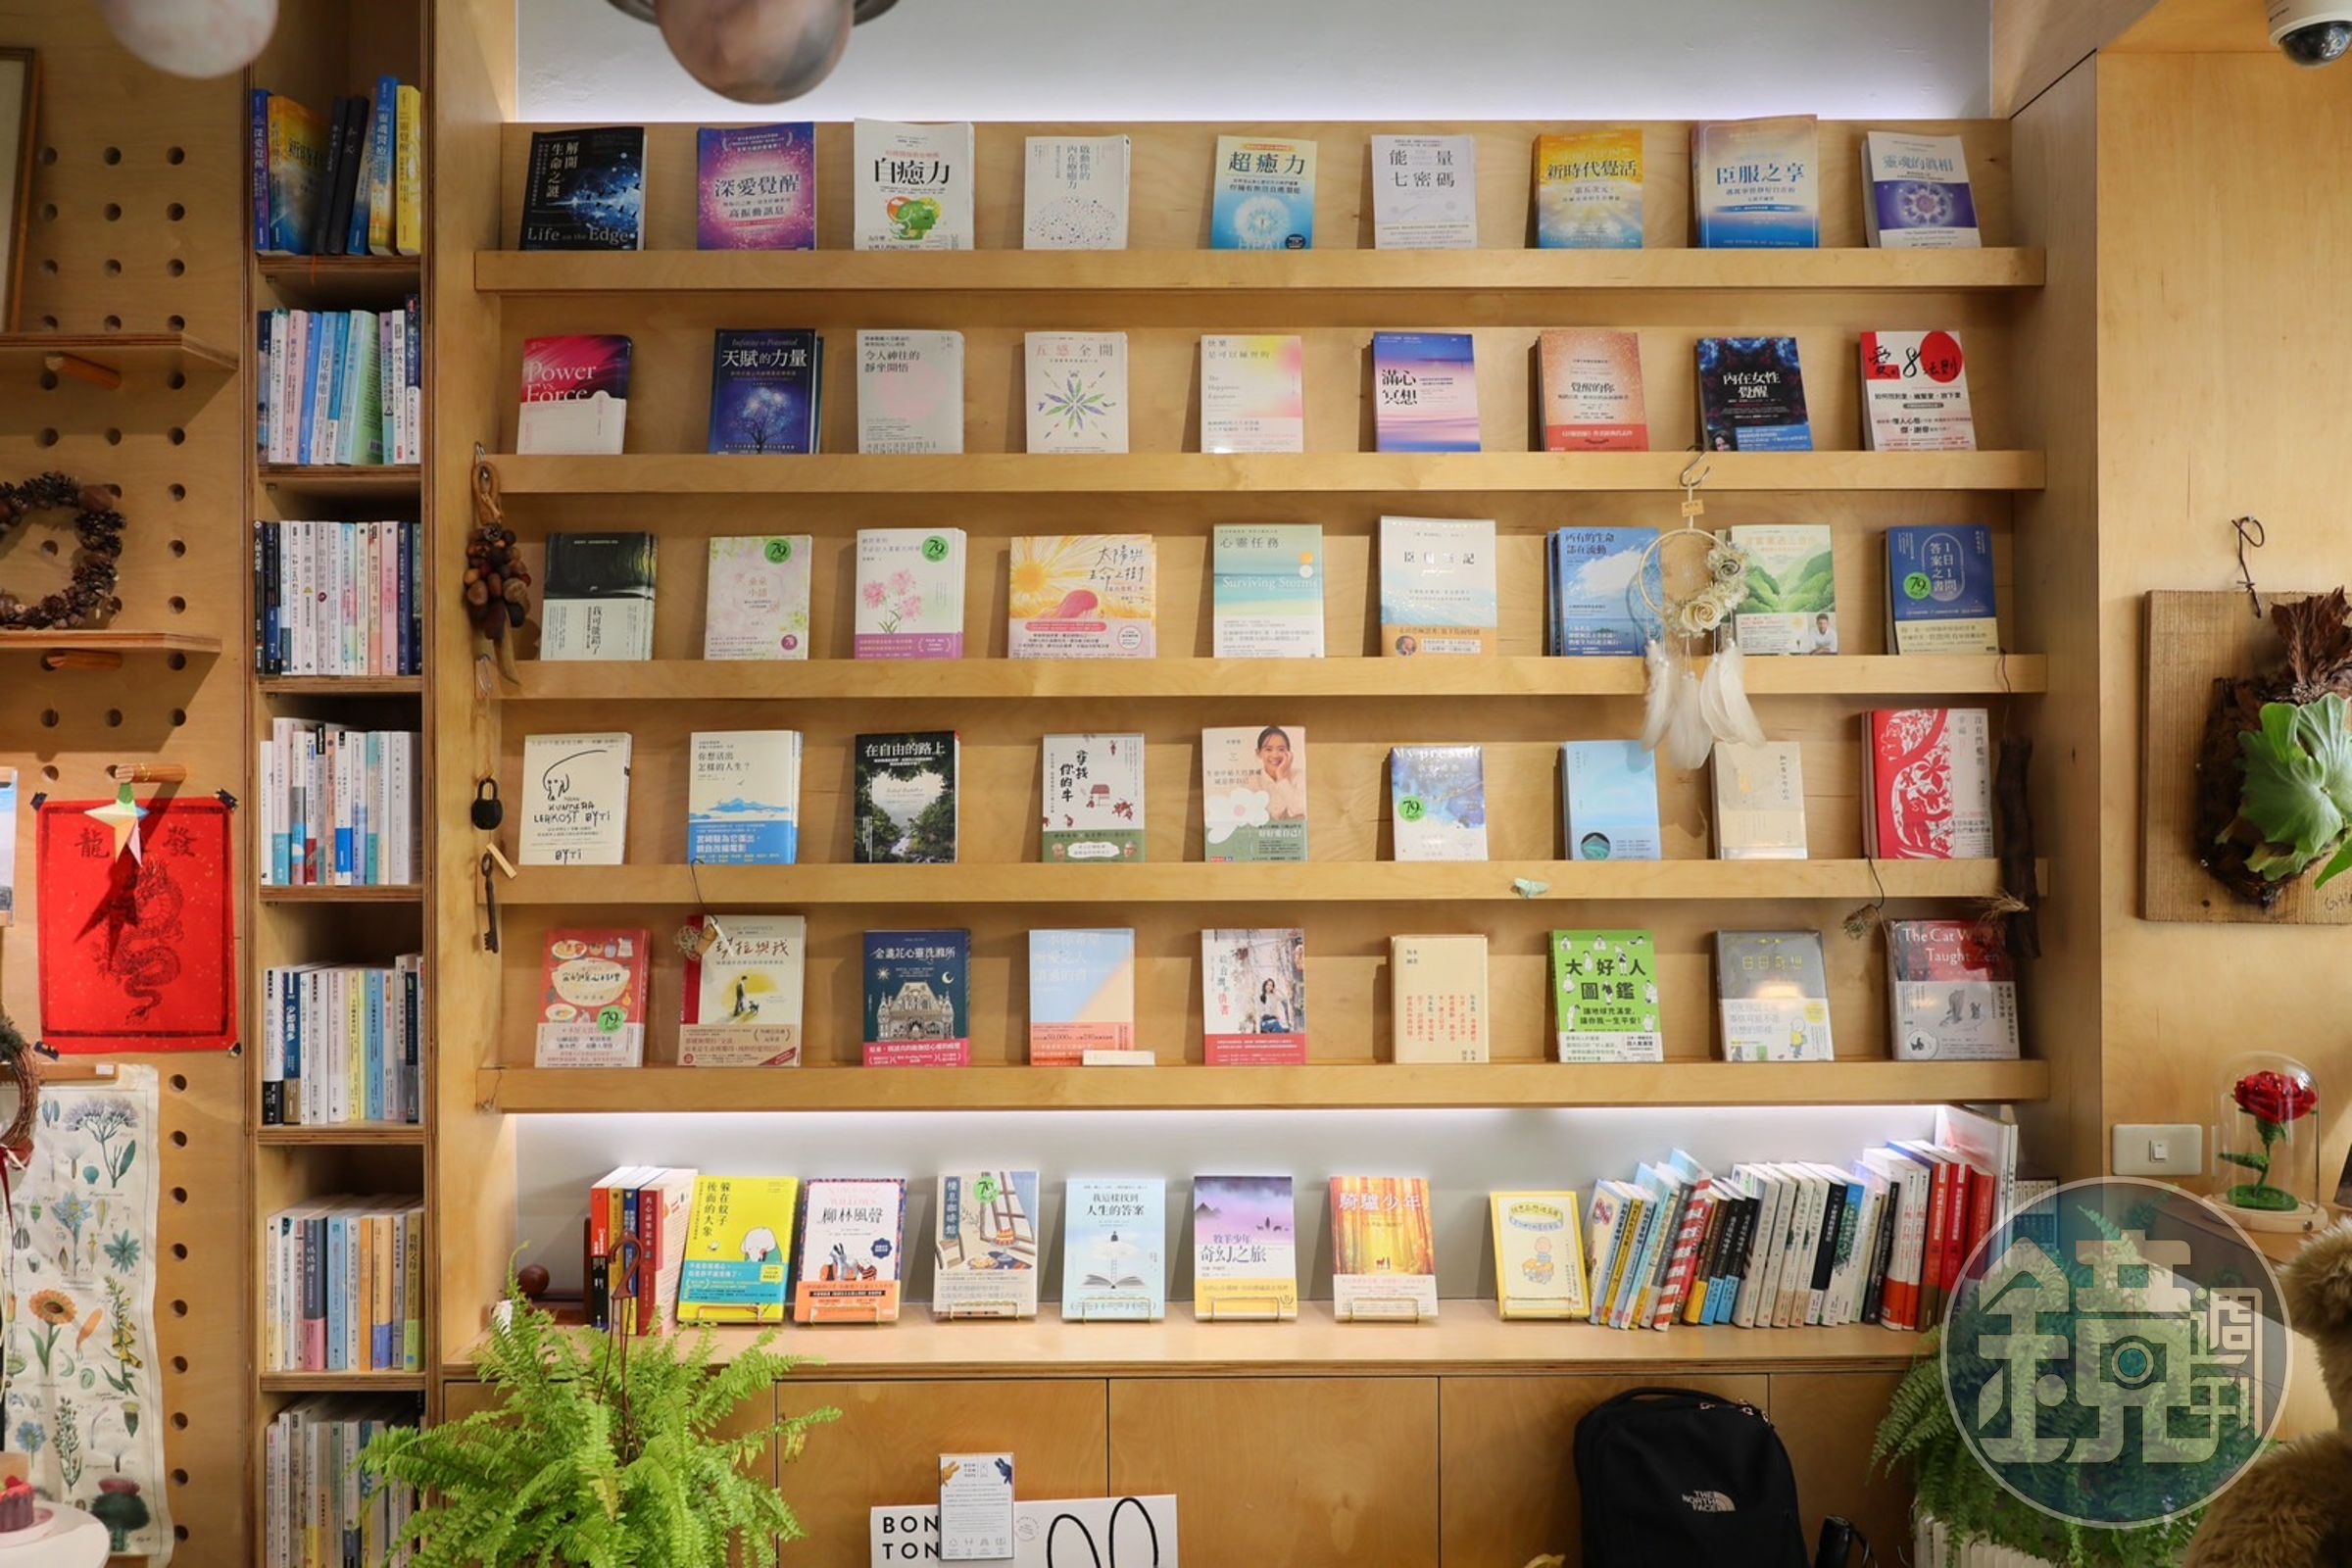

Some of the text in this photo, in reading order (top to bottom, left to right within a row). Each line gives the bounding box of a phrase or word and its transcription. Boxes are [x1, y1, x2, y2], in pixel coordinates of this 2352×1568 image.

[564, 141, 579, 171] 解開
[1228, 152, 1305, 175] 超癒力
[547, 142, 565, 198] 生命之謎
[874, 157, 950, 185] 自癒力
[1546, 160, 1638, 180] 新時代覺活
[1716, 163, 1805, 185] 臣服之享
[713, 174, 800, 197] 深愛覺醒
[1394, 172, 1455, 188] 七密碼
[527, 227, 560, 242] Life
[589, 227, 629, 245] Edge
[722, 350, 808, 368] 天賦的力量
[864, 351, 920, 362] 令人神往的
[528, 360, 597, 382] Power
[1382, 369, 1416, 387] 滿心
[1723, 372, 1782, 386] 內在女性
[526, 382, 588, 403] Force
[1383, 389, 1417, 406] 冥想
[927, 542, 946, 555] 79
[1219, 536, 1280, 549] 心靈任務
[1942, 542, 1957, 592] 1日1問
[1222, 576, 1318, 589] Surviving Storms
[1910, 575, 1928, 590] 79
[697, 752, 734, 761] 你想活出
[864, 742, 946, 758] 在自由的路上
[1059, 762, 1074, 803] 你的牛
[1402, 800, 1421, 815] 79
[74, 825, 200, 860] 龍 發
[1903, 927, 1928, 942] The
[1930, 928, 1954, 943] Cat
[1925, 948, 1971, 965] Taught
[1565, 958, 1646, 978] 大好人
[1581, 982, 1636, 1001] 圖鑑
[600, 1009, 619, 1025] 79
[718, 1182, 732, 1226] 躲在蚊子
[1093, 1192, 1139, 1202] 我這樣找到
[703, 1182, 717, 1238] 後面的大象
[821, 1207, 884, 1225] 柳林風聲
[1086, 1203, 1145, 1216] 人生的答案
[1213, 1234, 1250, 1245] 牧羊少年
[1200, 1245, 1267, 1262] 奇幻之旅
[882, 1516, 941, 1535] BON
[882, 1543, 941, 1560] TON
